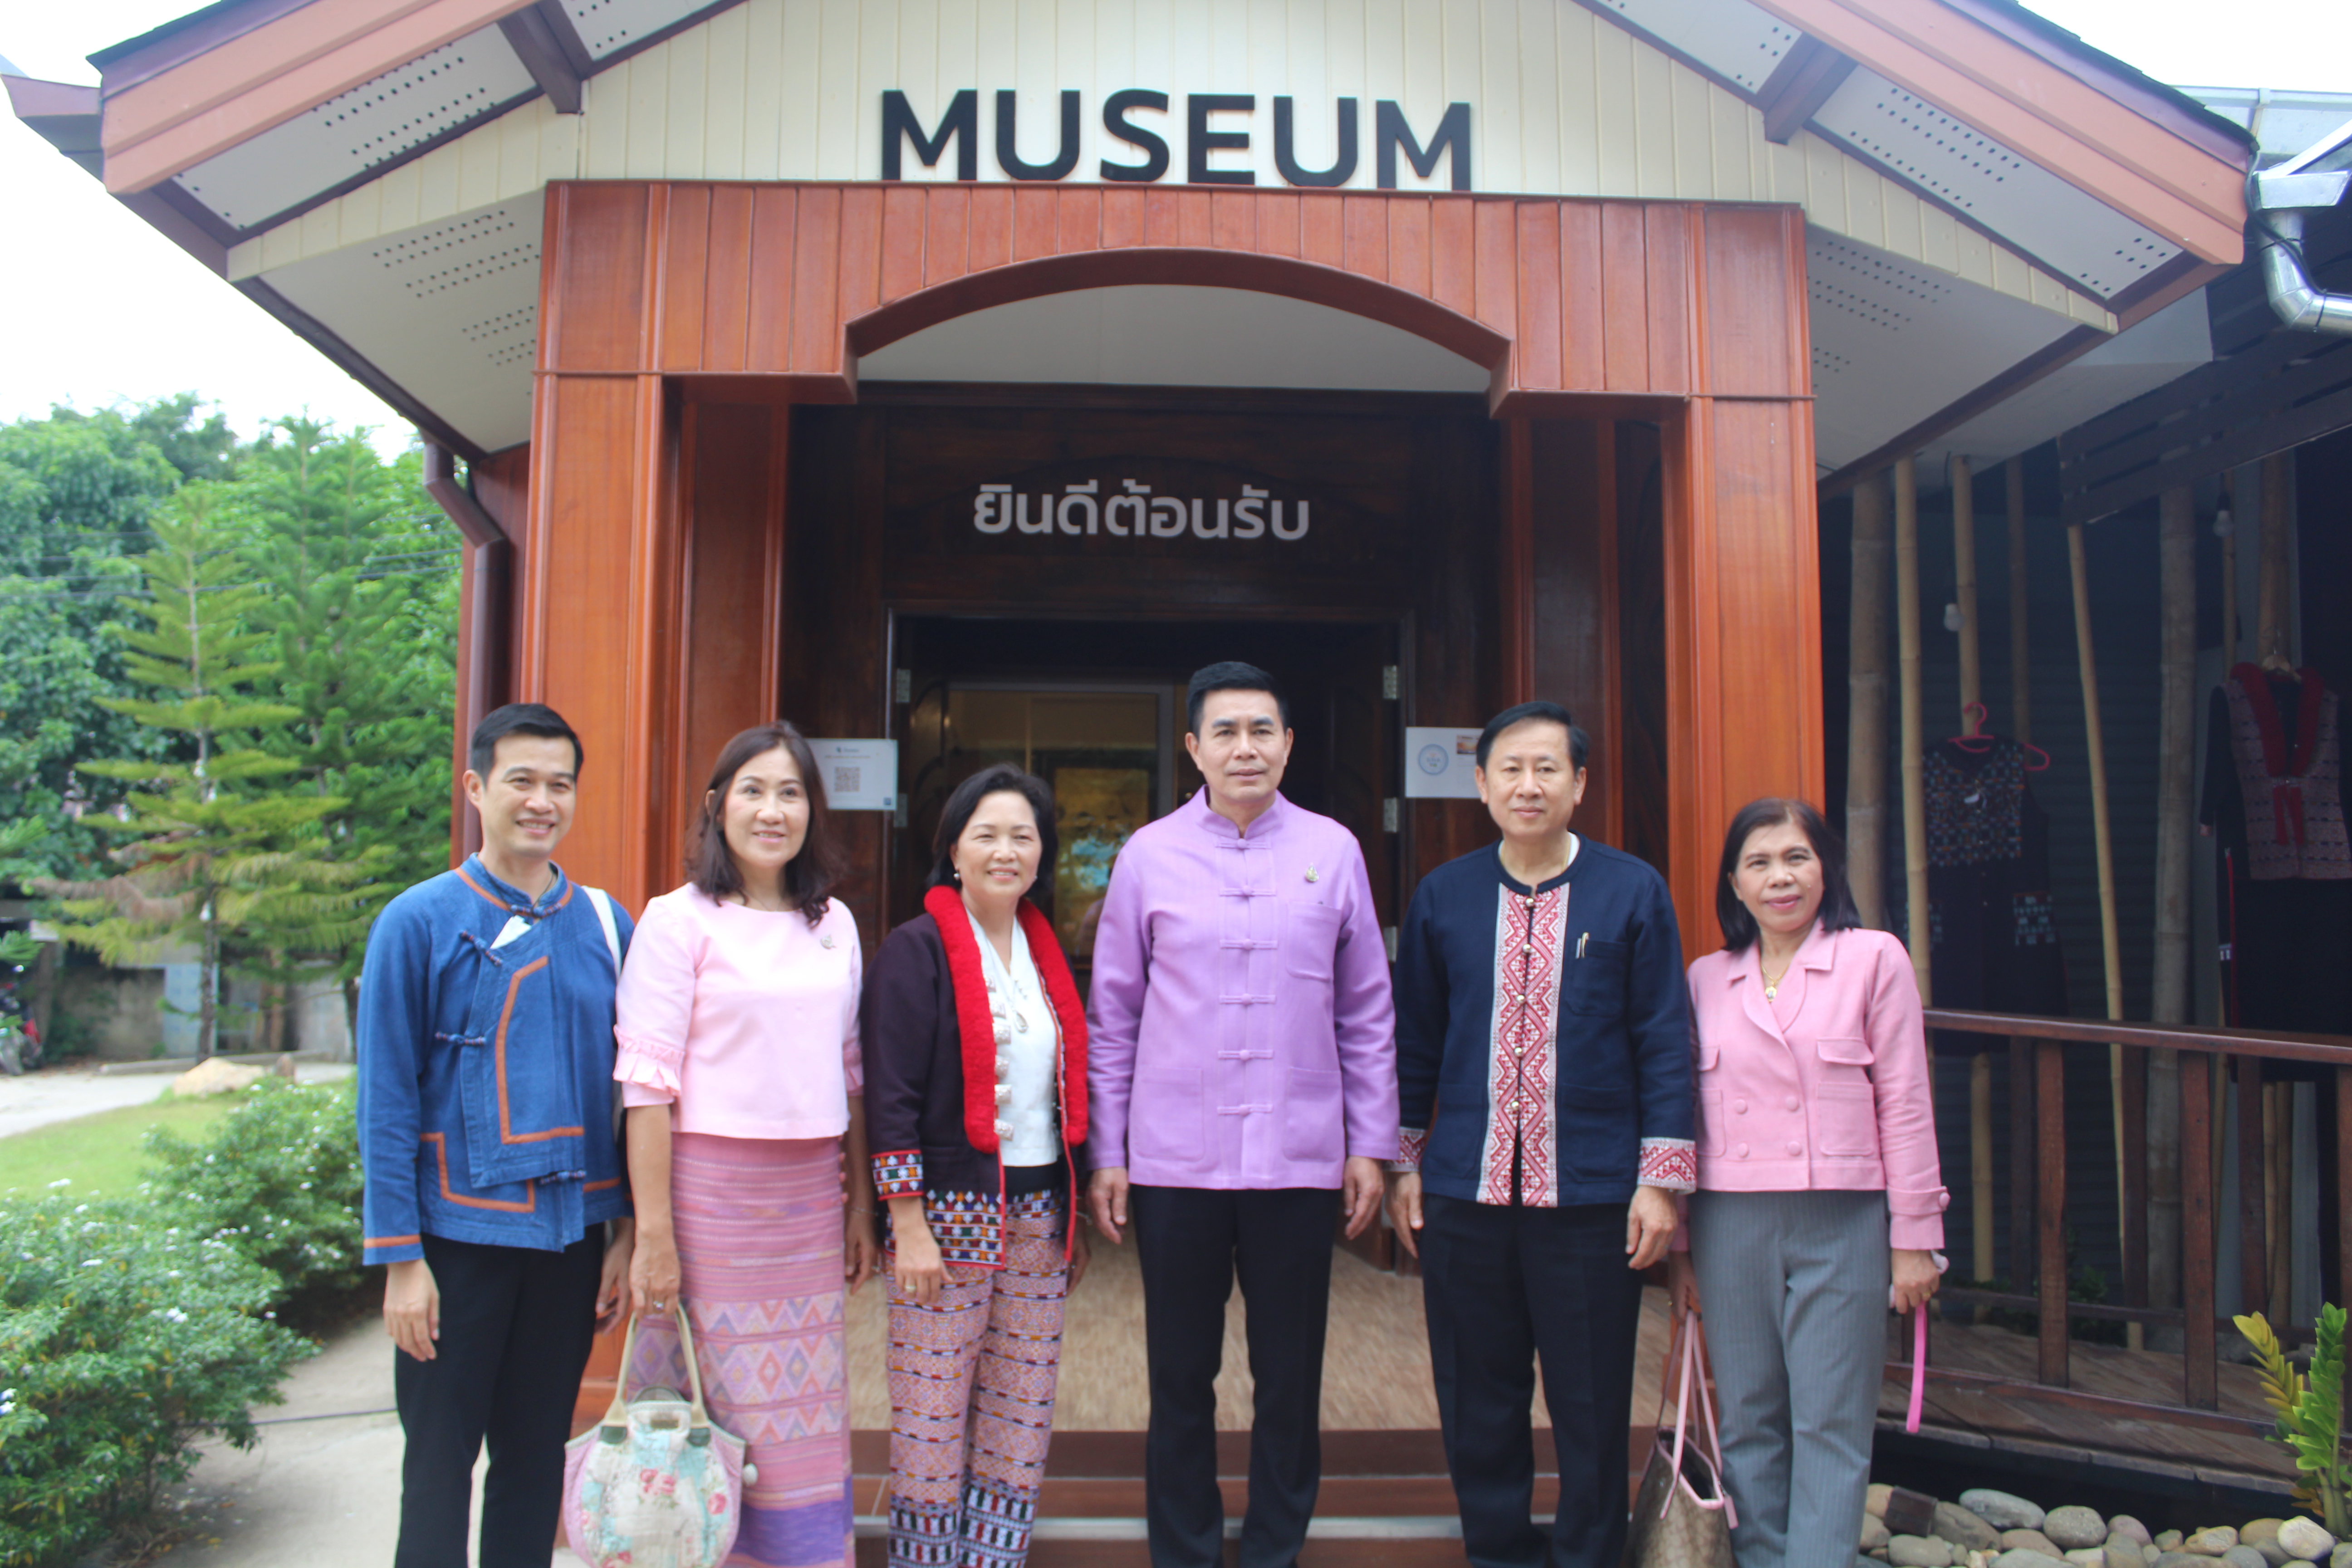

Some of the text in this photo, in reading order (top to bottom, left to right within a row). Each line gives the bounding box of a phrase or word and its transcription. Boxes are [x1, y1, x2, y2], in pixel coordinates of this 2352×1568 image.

[881, 88, 1472, 192] MUSEUM
[974, 479, 1309, 540] ยินดีต้อนรับ
